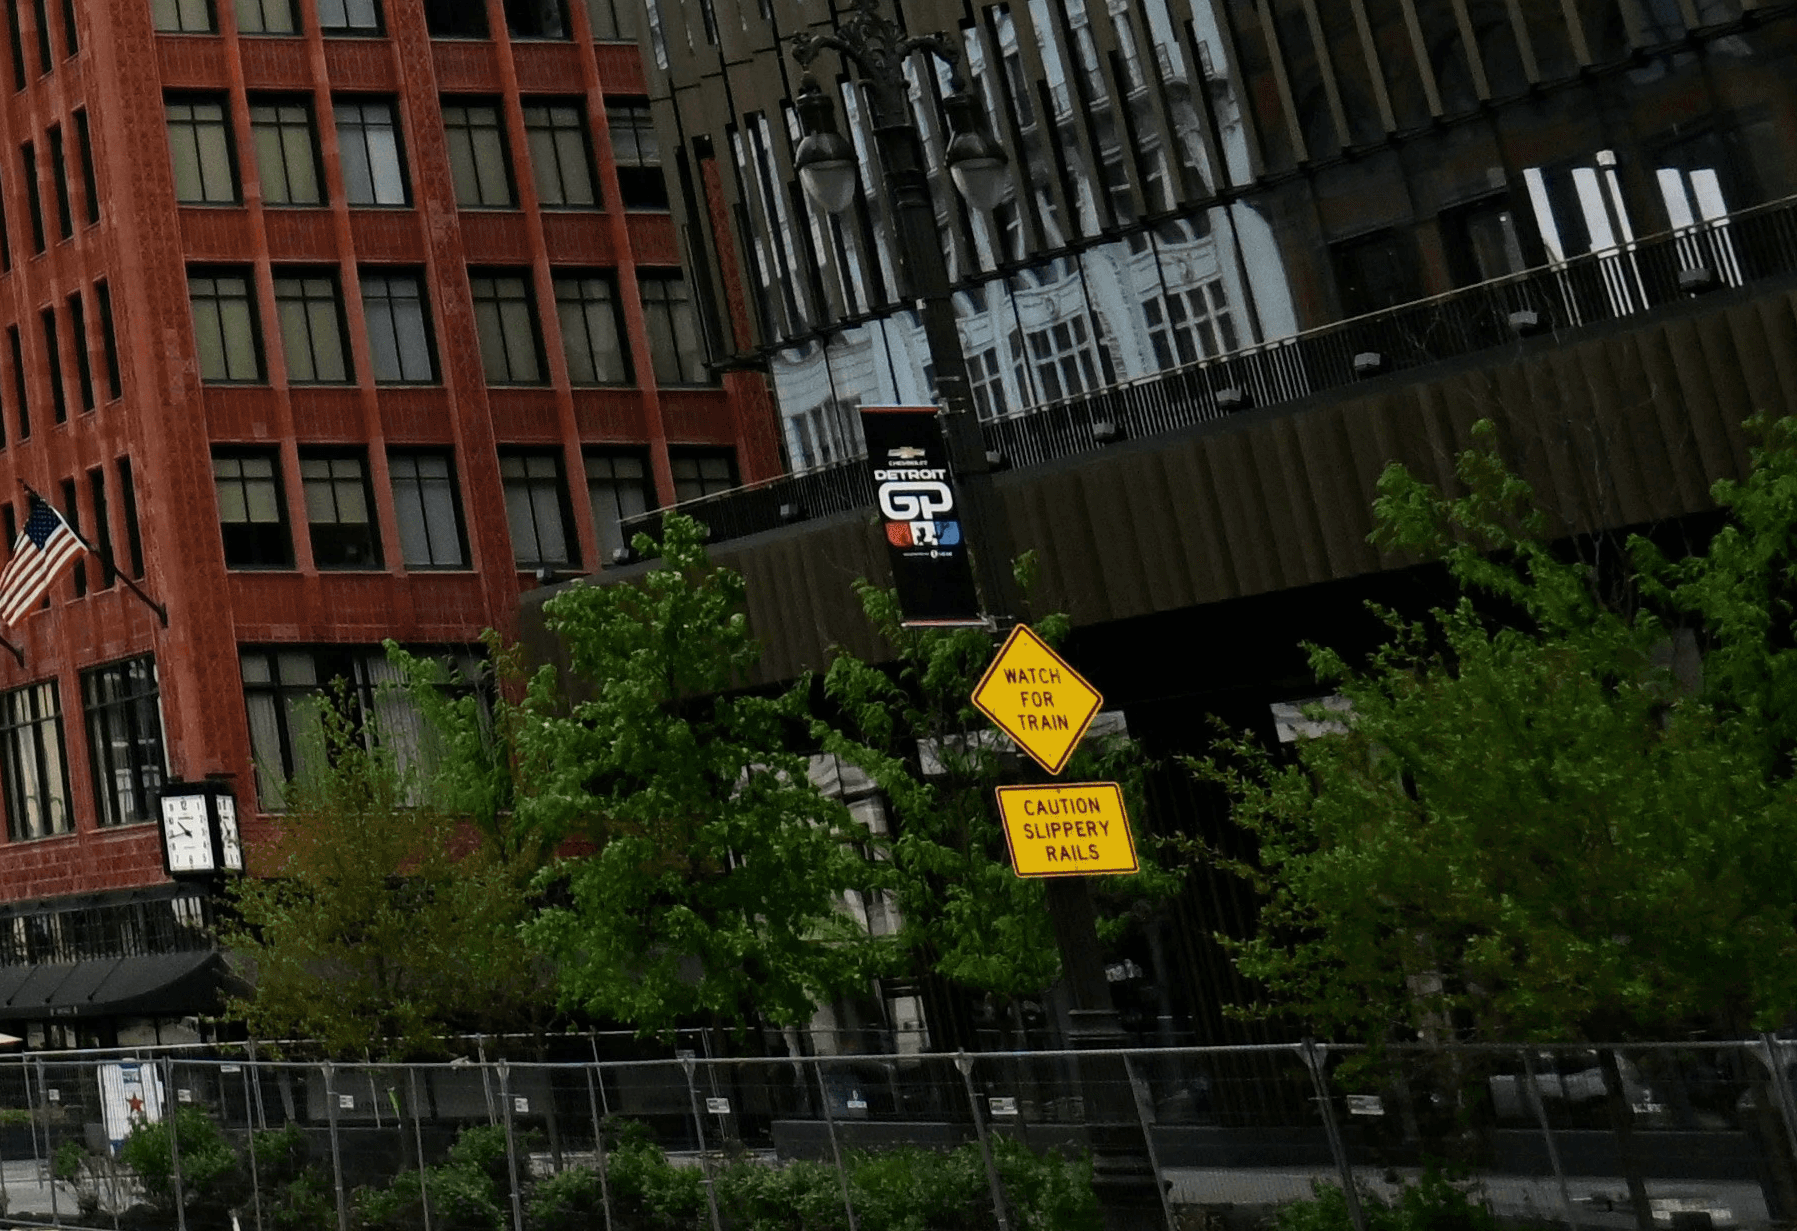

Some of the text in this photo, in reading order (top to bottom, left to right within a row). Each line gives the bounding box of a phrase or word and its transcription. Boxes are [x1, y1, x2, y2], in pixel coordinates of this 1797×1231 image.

[874, 469, 947, 480] DETROIT
[878, 481, 954, 521] GP
[1003, 666, 1062, 686] WATCH
[1020, 691, 1055, 709] FOR
[1017, 714, 1070, 732] TRAIN
[1023, 797, 1102, 817] CAUTION
[1022, 820, 1111, 840] SLIPPERY
[1046, 843, 1101, 863] RAILS
